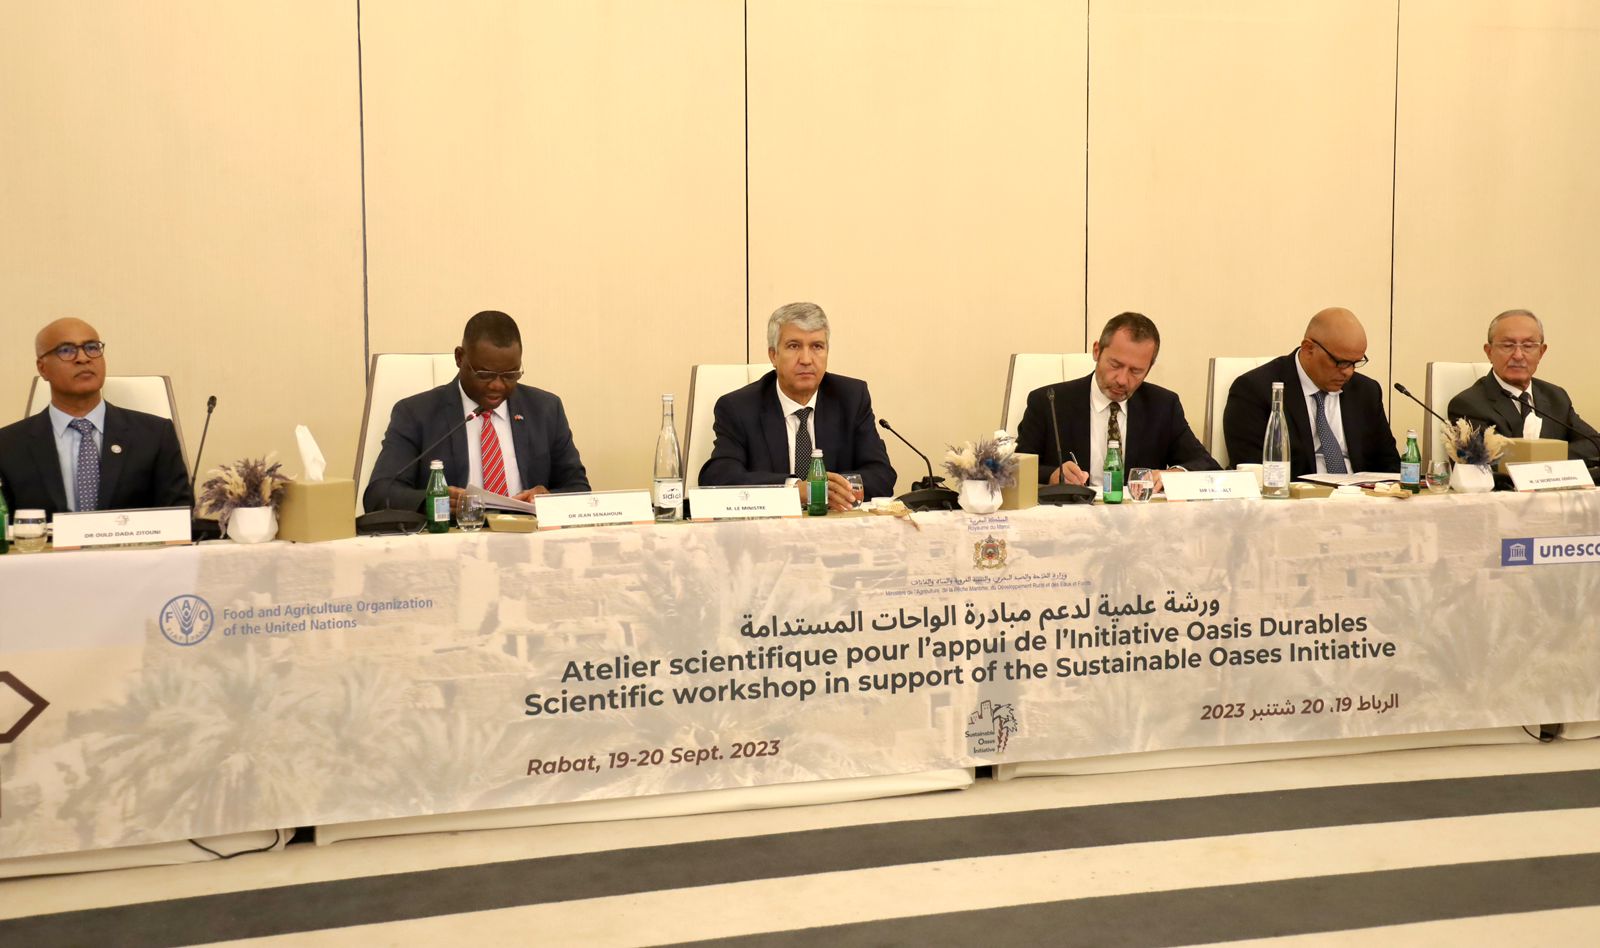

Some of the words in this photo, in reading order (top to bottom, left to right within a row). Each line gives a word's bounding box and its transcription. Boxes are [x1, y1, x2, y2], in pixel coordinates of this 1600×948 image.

[223, 608, 254, 620] Food
[257, 605, 281, 618] and
[284, 602, 353, 620] Agriculture
[356, 598, 433, 614] Organization
[964, 601, 1032, 630] مبادرة
[1039, 597, 1091, 631] لدعم
[1098, 593, 1157, 623] علمية
[1164, 590, 1220, 617] ورشة
[223, 623, 239, 636] of
[241, 622, 261, 636] the
[265, 620, 306, 634] United
[310, 617, 357, 631] Nations
[740, 610, 863, 639] المستدامة
[871, 604, 957, 633] الواحات
[560, 655, 660, 683] Atelier
[669, 644, 838, 676] scientifique
[847, 642, 910, 668] pour
[918, 631, 1006, 660] l’appui
[1014, 630, 1047, 652] de
[1055, 622, 1179, 650] l’Initiative
[1186, 617, 1252, 642] Oasis
[1260, 612, 1368, 637] Durables
[524, 683, 665, 716] Scientific
[672, 676, 816, 705] workshop
[825, 671, 850, 694] in
[858, 664, 964, 694] support
[971, 659, 998, 683] of
[1004, 657, 1048, 681] the
[1056, 648, 1202, 678] Sustainable
[1209, 646, 1282, 668] Oases
[1290, 637, 1397, 662] Initiative
[1200, 702, 1246, 721] 2023
[1250, 700, 1296, 721] شتنبر
[1300, 699, 1325, 715] 20
[1357, 693, 1400, 714] الرباط
[526, 755, 601, 776] Rabat,
[608, 749, 665, 770] 19-20
[670, 745, 724, 766] Sept.
[729, 740, 781, 760] 2023
